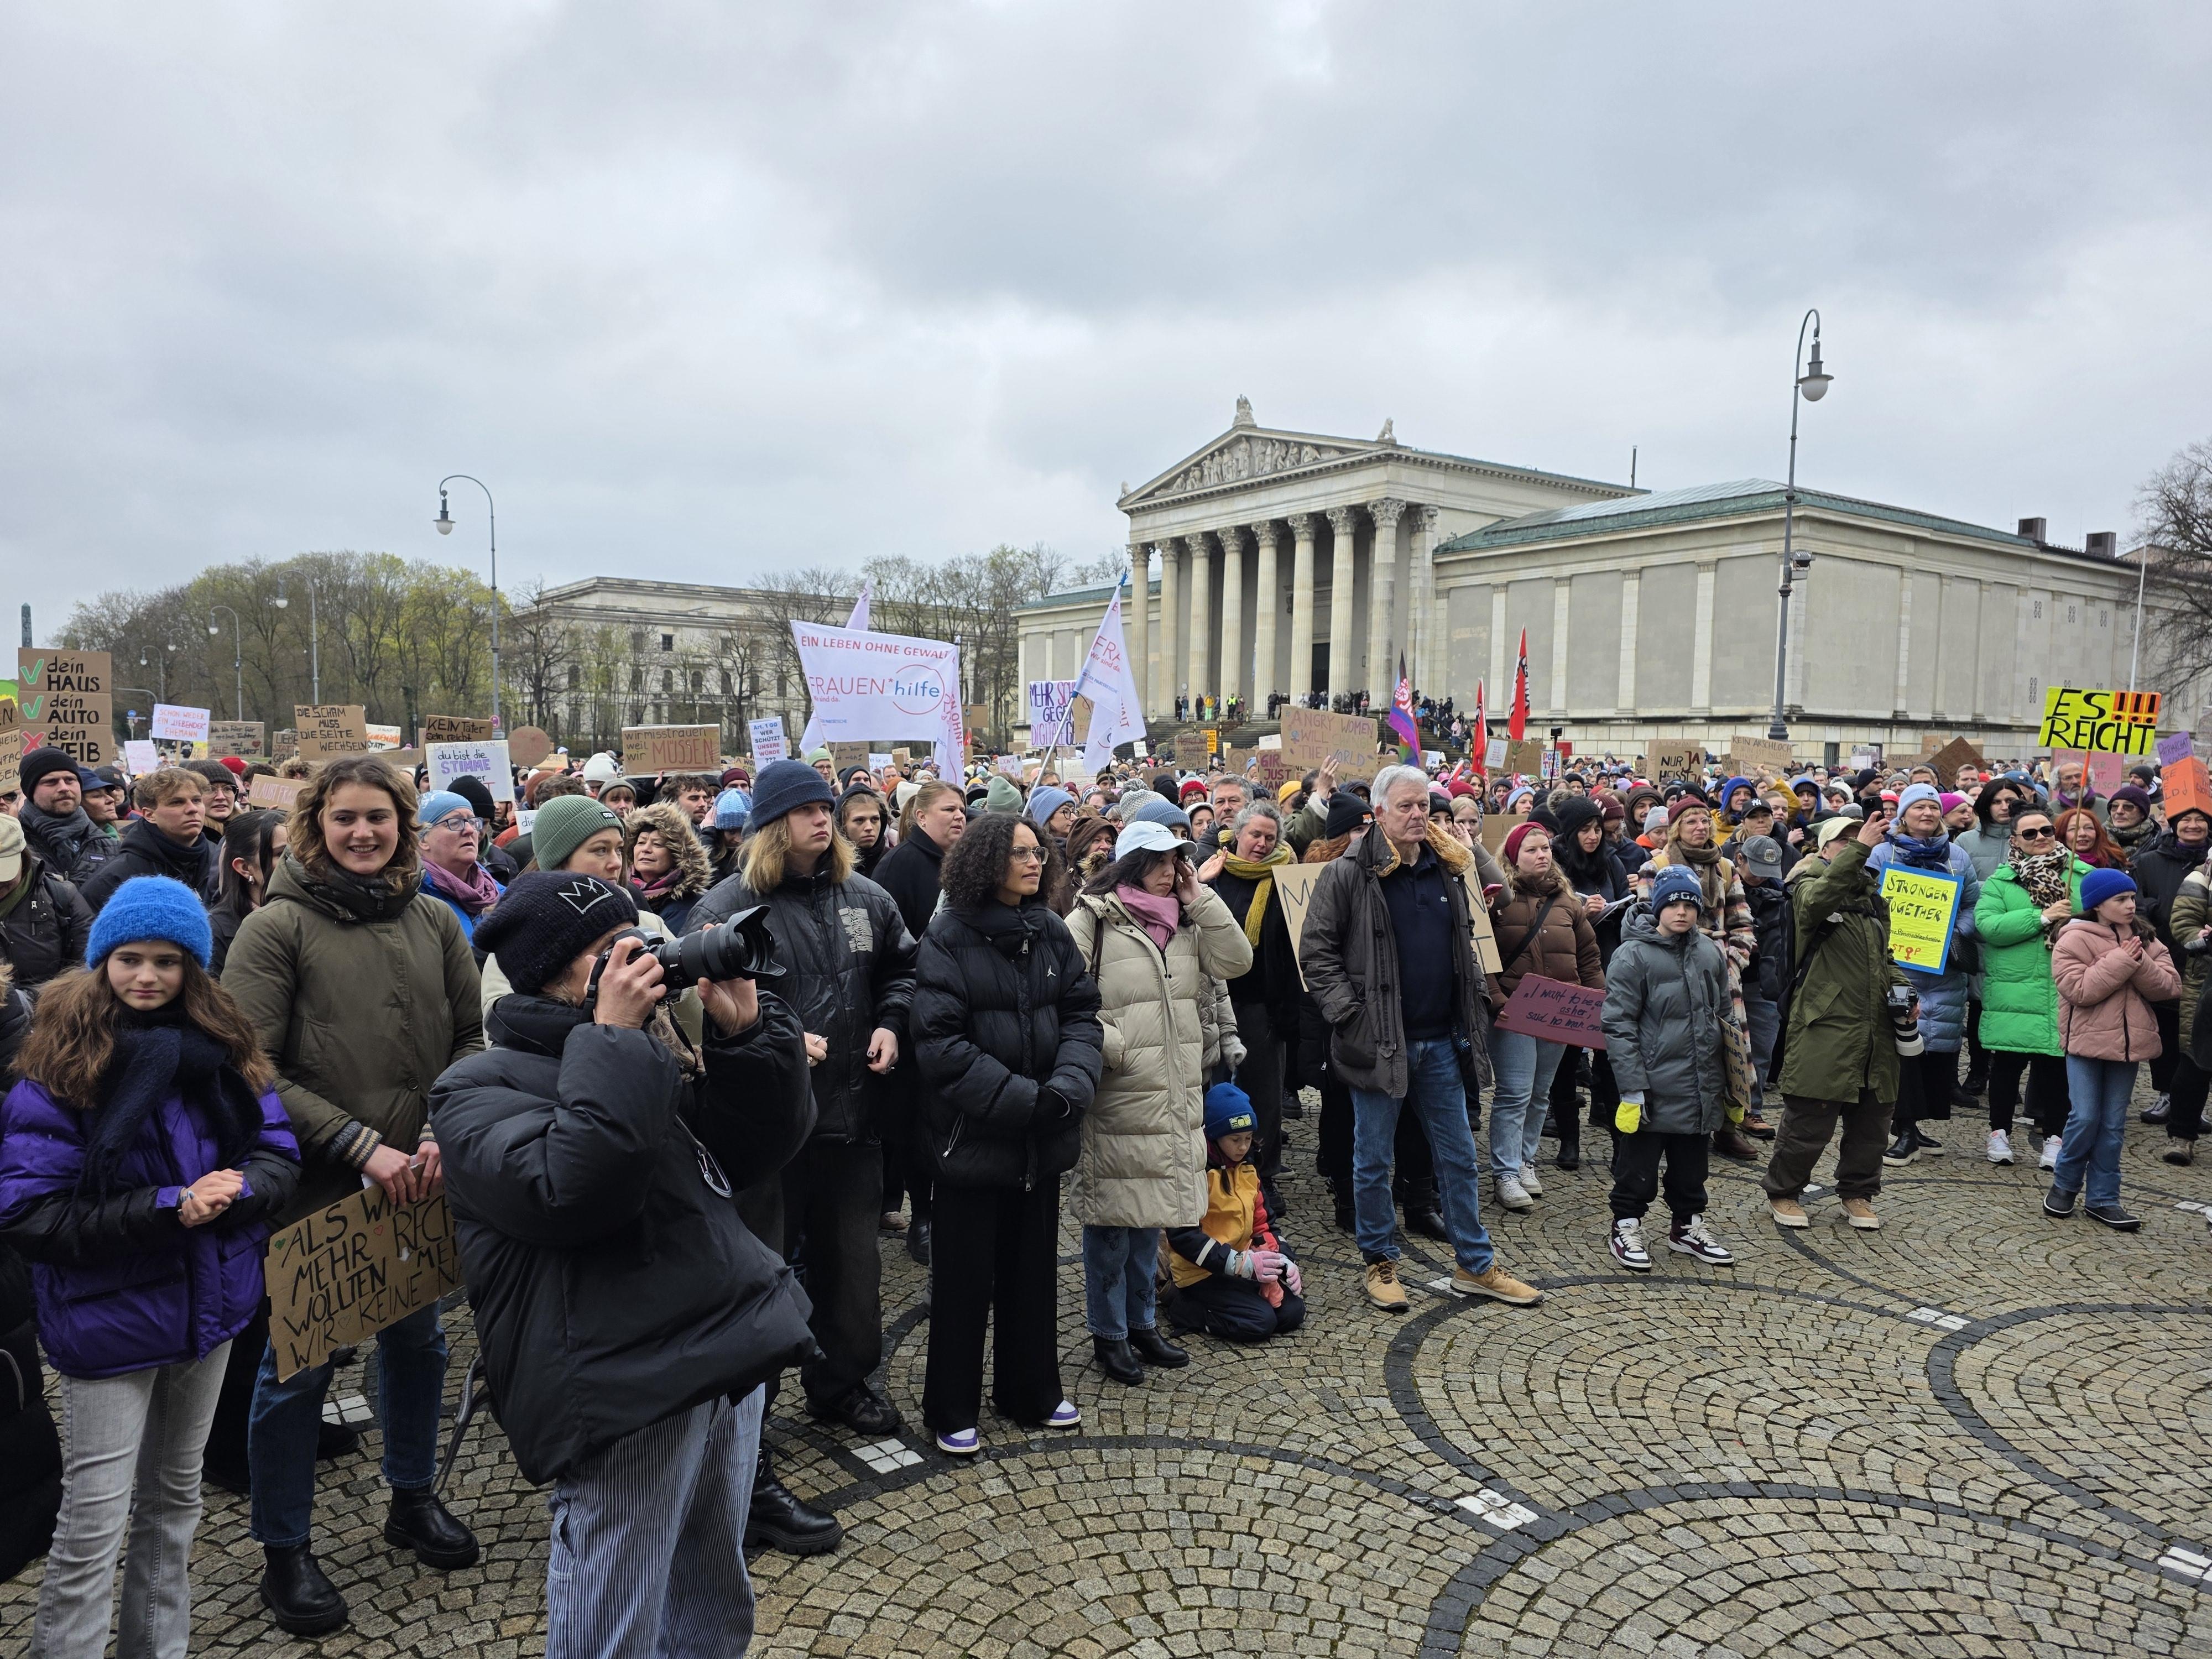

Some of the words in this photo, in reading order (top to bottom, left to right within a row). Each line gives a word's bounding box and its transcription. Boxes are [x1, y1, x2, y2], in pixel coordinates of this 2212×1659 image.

[801, 636, 818, 646] EIN
[823, 638, 861, 650] LEBEN
[865, 642, 900, 654] OHNE
[46, 655, 84, 675] dein
[1090, 651, 1100, 660] Wir
[1100, 658, 1113, 668] sind
[47, 675, 100, 692] HAUS
[50, 693, 83, 709] dein
[1029, 682, 1055, 707] MEHR
[296, 705, 311, 718] DIE
[311, 707, 347, 718] SCHAM
[2051, 688, 2111, 719] ES
[47, 709, 100, 724] AUTO
[159, 708, 180, 717] SCHON
[182, 711, 205, 720] WIEDER
[1290, 710, 1334, 731] ANGRY
[244, 725, 256, 733] für
[318, 719, 341, 728] MUSS
[427, 718, 461, 732] KEIN
[461, 721, 486, 734] Täter
[1340, 718, 1374, 737] WOMEN
[48, 725, 86, 742] dein
[164, 727, 198, 738] EHEMANN
[275, 733, 299, 745] LIEBE
[300, 728, 318, 740] DIE
[319, 727, 354, 739] SEITE
[446, 732, 473, 742] reicht
[754, 735, 780, 744] SCHÜTZT
[1301, 729, 1328, 744] WILL
[2045, 716, 2156, 755] REICHT
[48, 742, 101, 763] EIB
[319, 740, 368, 752] WECHSELN
[367, 740, 385, 750] STATT
[626, 740, 649, 750] weil
[626, 752, 646, 761] wir
[652, 738, 714, 765] MÜSSEN
[1300, 745, 1322, 759] THE
[1733, 735, 1751, 746] KEIN
[1752, 739, 1792, 753] ARSCHLOCH
[437, 750, 451, 760] du
[452, 749, 471, 761] bist
[473, 749, 487, 759] die
[1660, 755, 1683, 767] NUR
[1681, 750, 1700, 772] JA
[440, 758, 492, 774] STIMME
[1264, 768, 1292, 781] JUST
[1886, 874, 1949, 902] STRONGER
[1885, 896, 1942, 922] TOGETHER
[1540, 988, 1568, 1003] want
[1568, 992, 1581, 1005] to
[1581, 995, 1594, 1007] be
[1526, 1010, 1548, 1023] said
[1550, 1016, 1563, 1026] no
[1564, 1019, 1584, 1029] man
[281, 1203, 348, 1269] ALS
[291, 1232, 373, 1307] MEHR
[283, 1256, 387, 1338] WOLLTEN
[290, 1316, 339, 1369] WIR
[358, 1271, 424, 1332] KEINE
